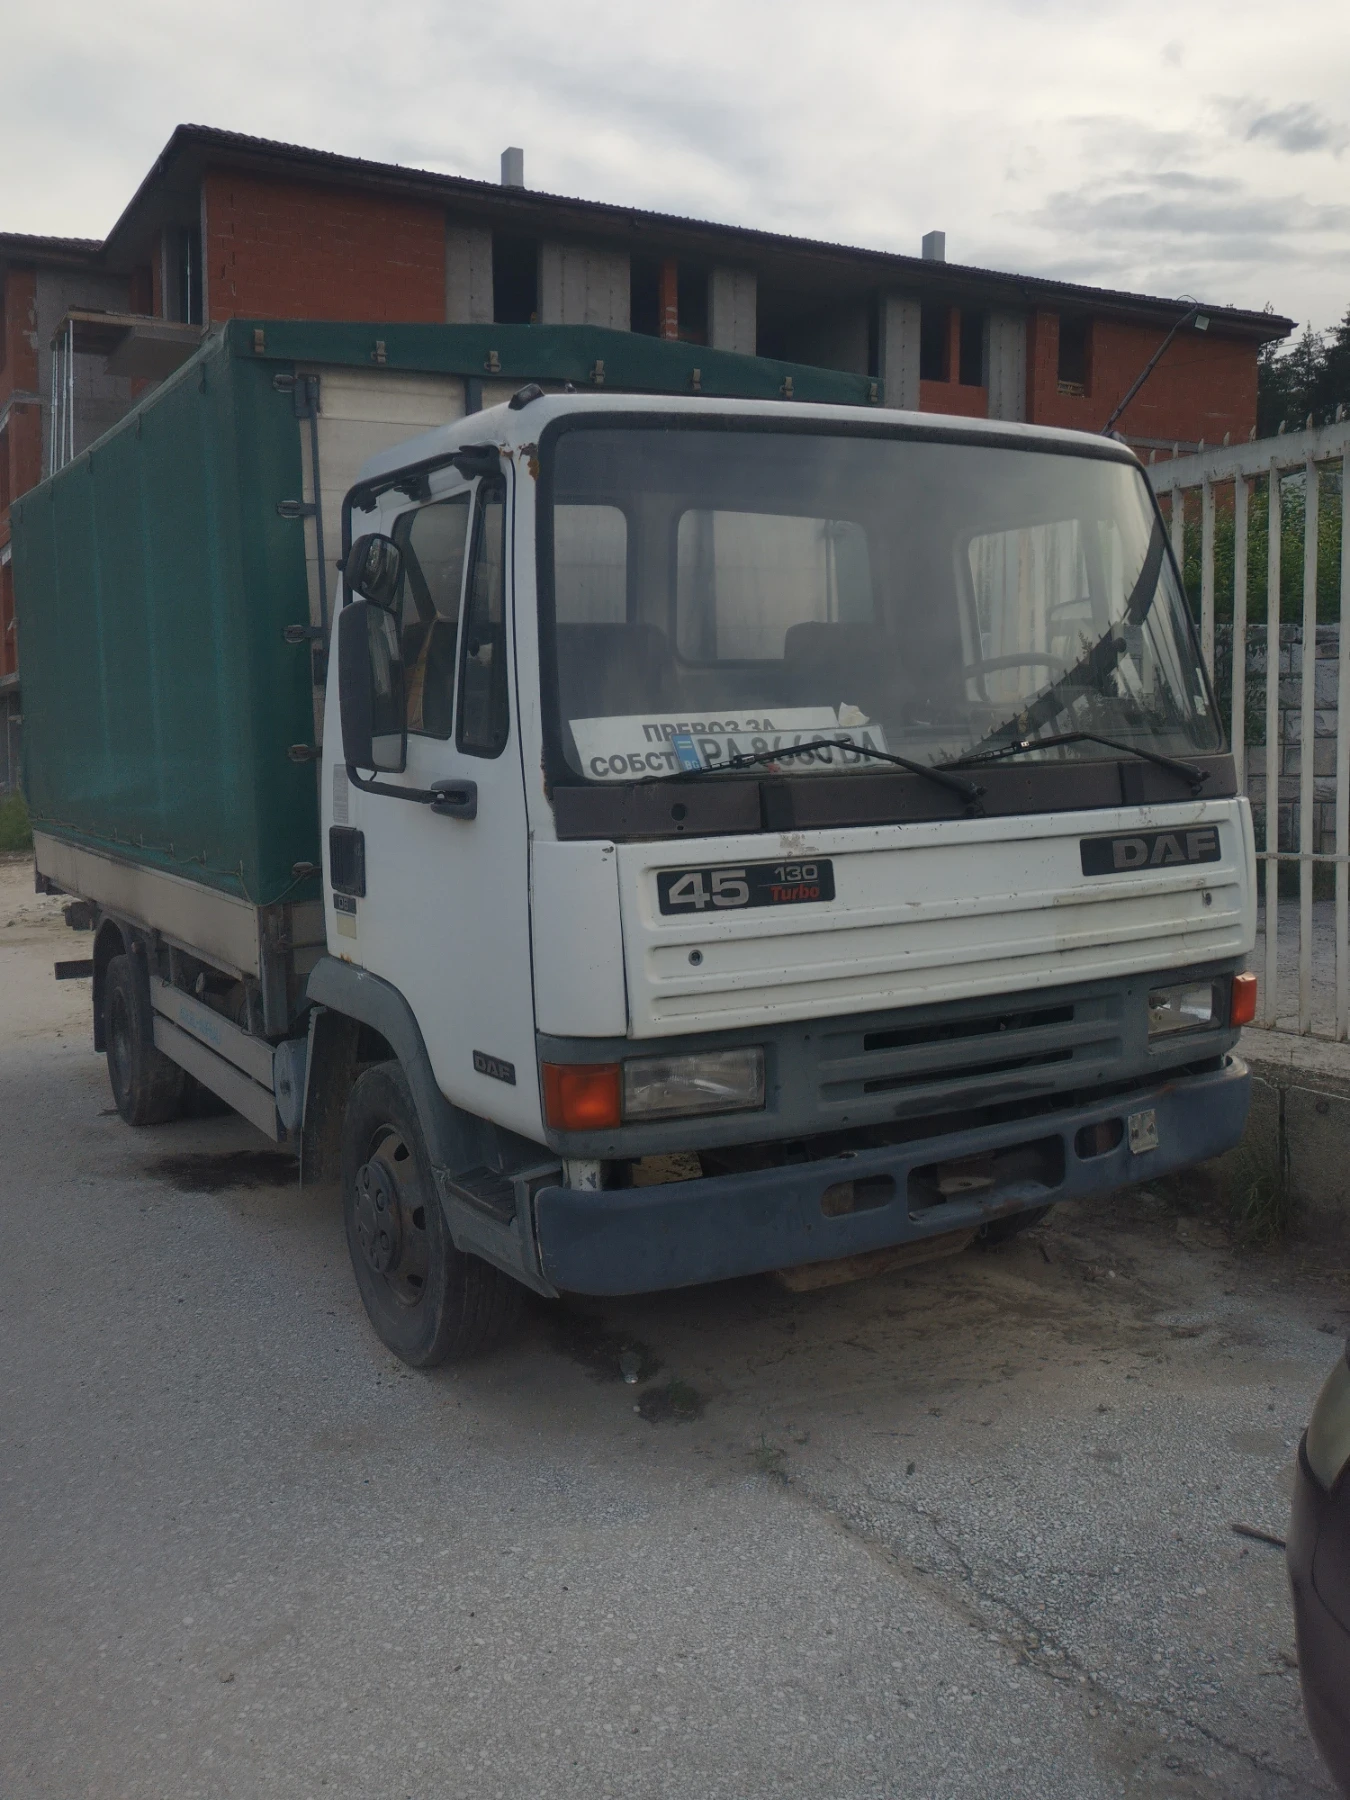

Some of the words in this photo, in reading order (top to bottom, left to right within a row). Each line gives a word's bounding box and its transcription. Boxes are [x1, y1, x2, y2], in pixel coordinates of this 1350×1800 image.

[684, 760, 700, 771] BG
[1112, 830, 1216, 868] DAF
[774, 864, 818, 882] 130
[668, 869, 750, 909] 45
[770, 884, 820, 901] Turbo
[475, 1055, 510, 1078] DAF
